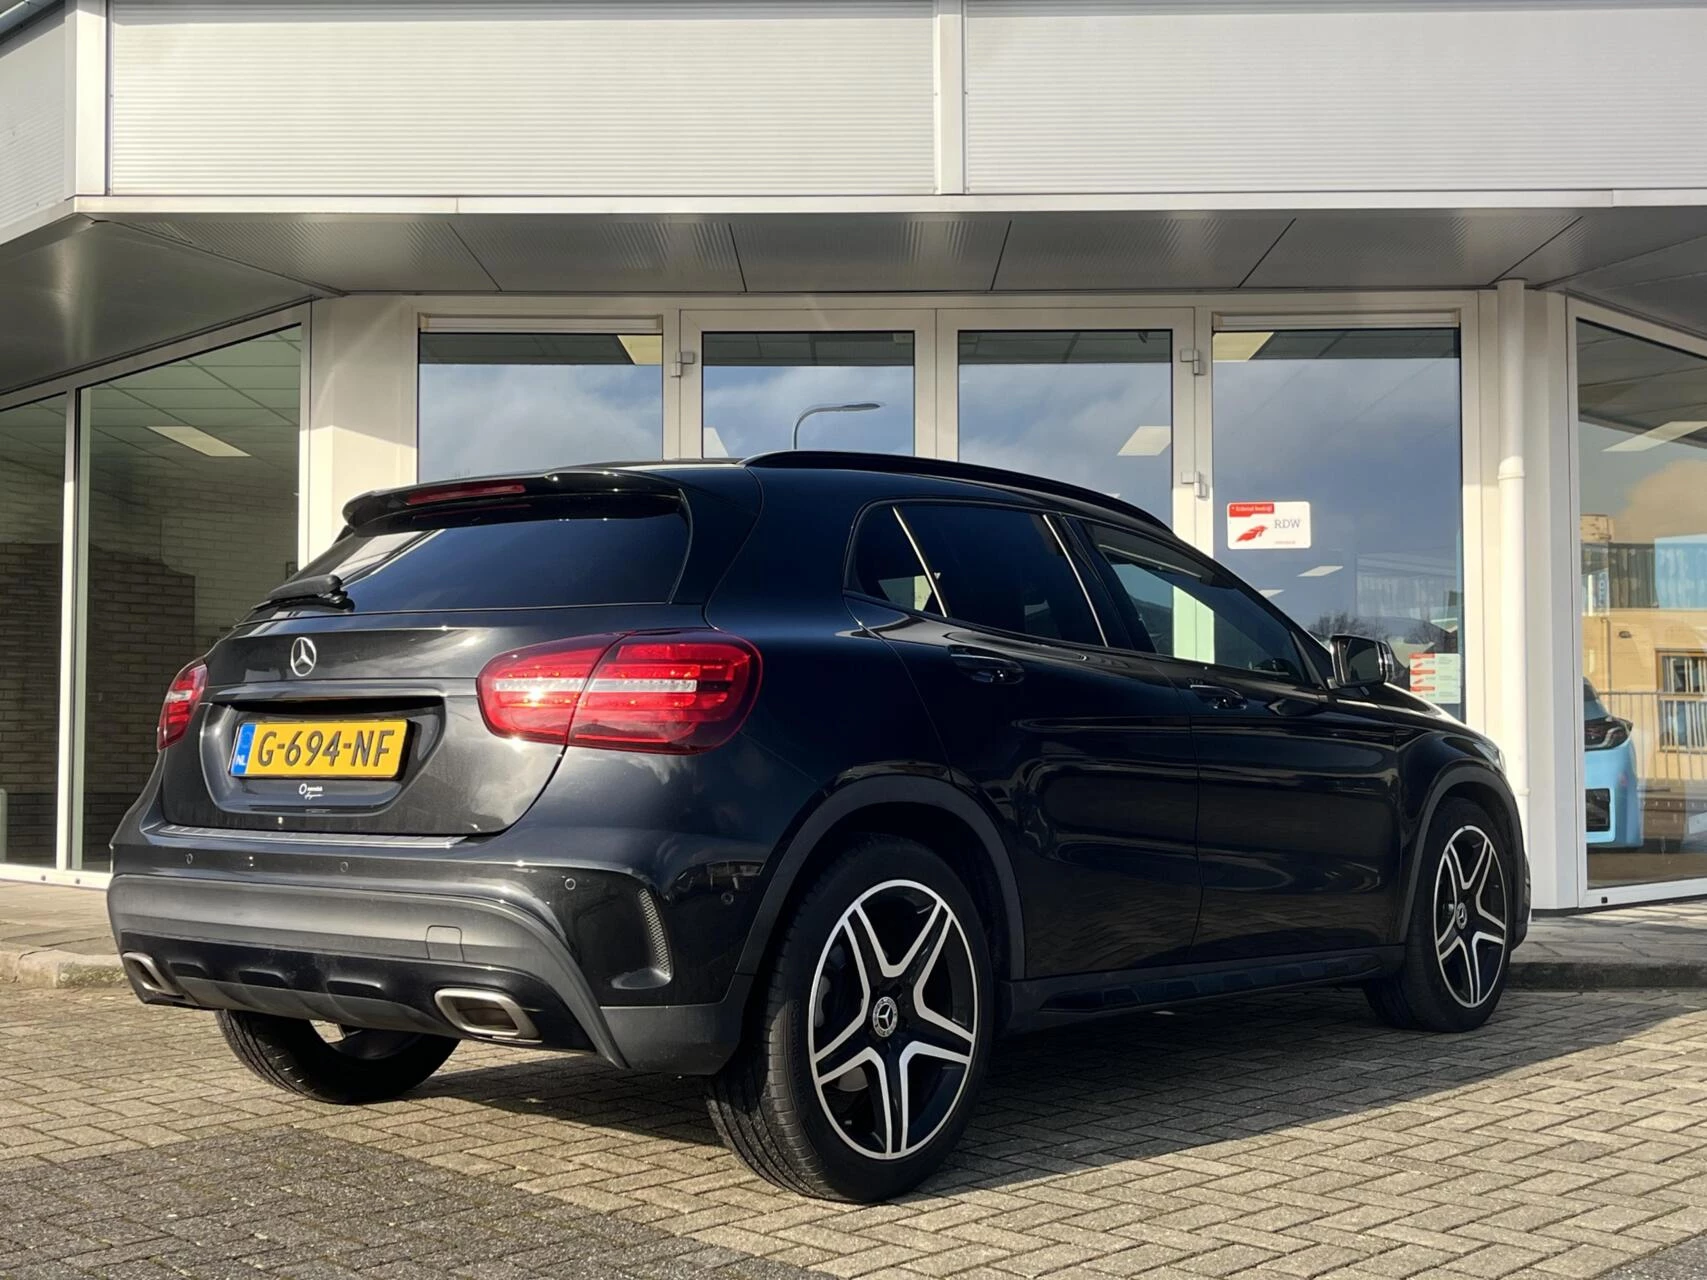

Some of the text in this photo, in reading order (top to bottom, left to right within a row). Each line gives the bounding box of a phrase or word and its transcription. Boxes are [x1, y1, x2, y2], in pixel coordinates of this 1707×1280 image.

[1274, 519, 1301, 529] RDW
[258, 730, 395, 767] G-694-NF
[235, 755, 247, 766] NL
